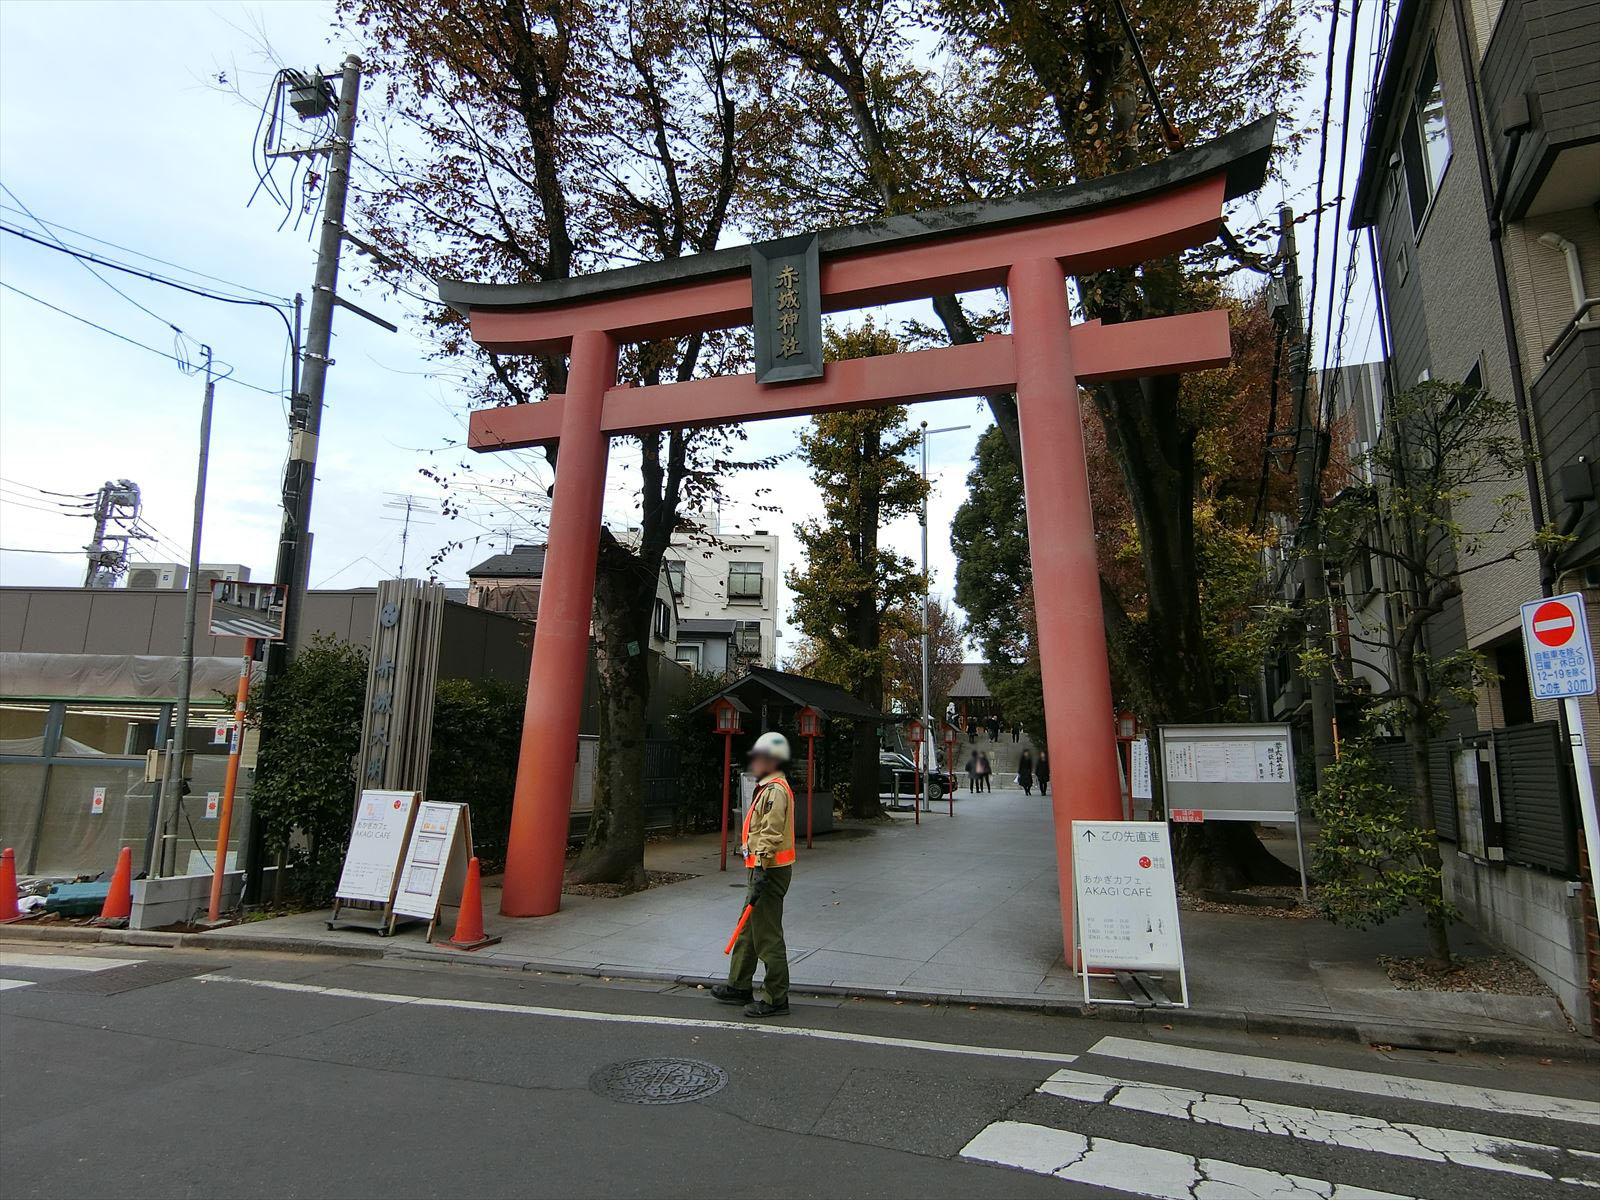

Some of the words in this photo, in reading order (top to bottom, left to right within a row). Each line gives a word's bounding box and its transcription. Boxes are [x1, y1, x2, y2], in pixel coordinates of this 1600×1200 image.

[775, 264, 803, 360] 赤城神社
[1535, 646, 1582, 661] 自転車を除く
[1539, 683, 1560, 694] この先
[1567, 679, 1588, 692] 30m
[1101, 831, 1160, 843] この先直進
[1083, 875, 1142, 885] あかぎカフェ
[1084, 887, 1119, 896] AKAGI
[1123, 887, 1152, 897] CAFÉ
